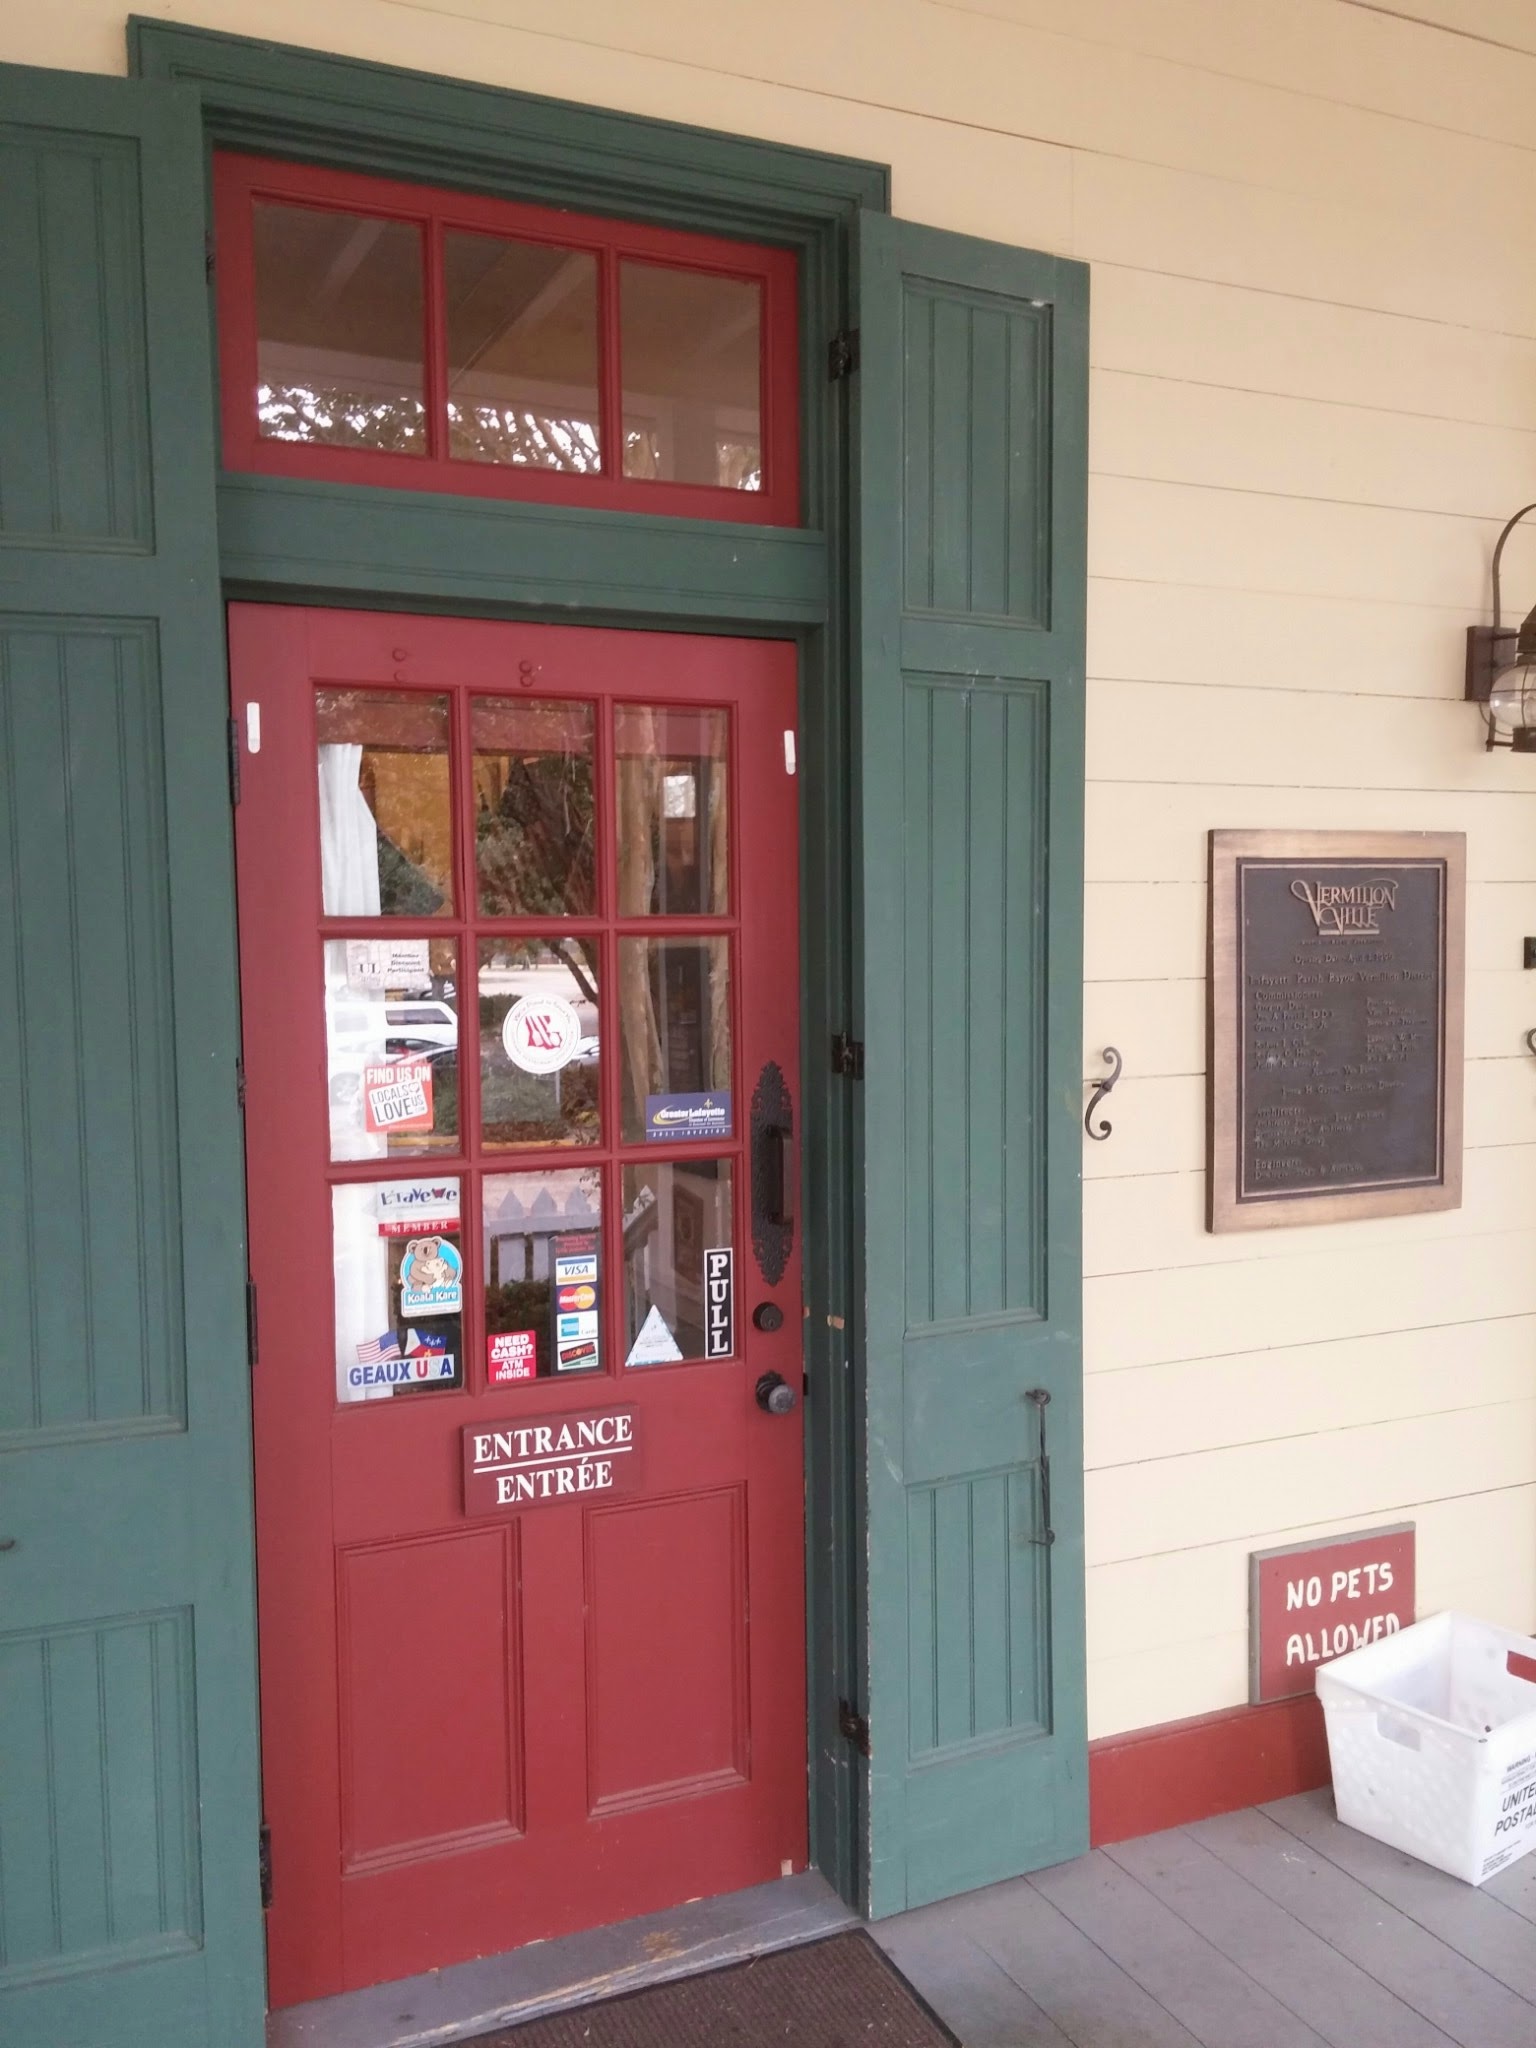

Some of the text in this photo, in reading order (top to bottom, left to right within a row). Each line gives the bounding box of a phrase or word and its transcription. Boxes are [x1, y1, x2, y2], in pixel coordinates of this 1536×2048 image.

[1290, 878, 1399, 926] VERMILION
[1319, 907, 1379, 935] VILLE
[367, 1066, 431, 1085] FIND US ON
[371, 1084, 409, 1105] LOCALS
[375, 1094, 424, 1123] LOVE US
[660, 1107, 725, 1118] Greater Lafayette
[391, 1220, 449, 1234] MEMBER
[564, 1264, 589, 1275] VISA
[407, 1289, 457, 1305] Koala Kare
[709, 1254, 729, 1353] PULL
[494, 1334, 530, 1348] NEED
[491, 1344, 534, 1359] CASH?
[561, 1345, 595, 1361] DISCOVER
[349, 1357, 453, 1386] GEAUX USA
[496, 1368, 530, 1381] INSIDE
[502, 1359, 524, 1370] ATM
[473, 1415, 633, 1463] ENTRANCE
[496, 1457, 613, 1504] ENTRÉE
[1286, 1562, 1394, 1611] NO PETS
[1502, 1782, 1536, 1813] UNITE
